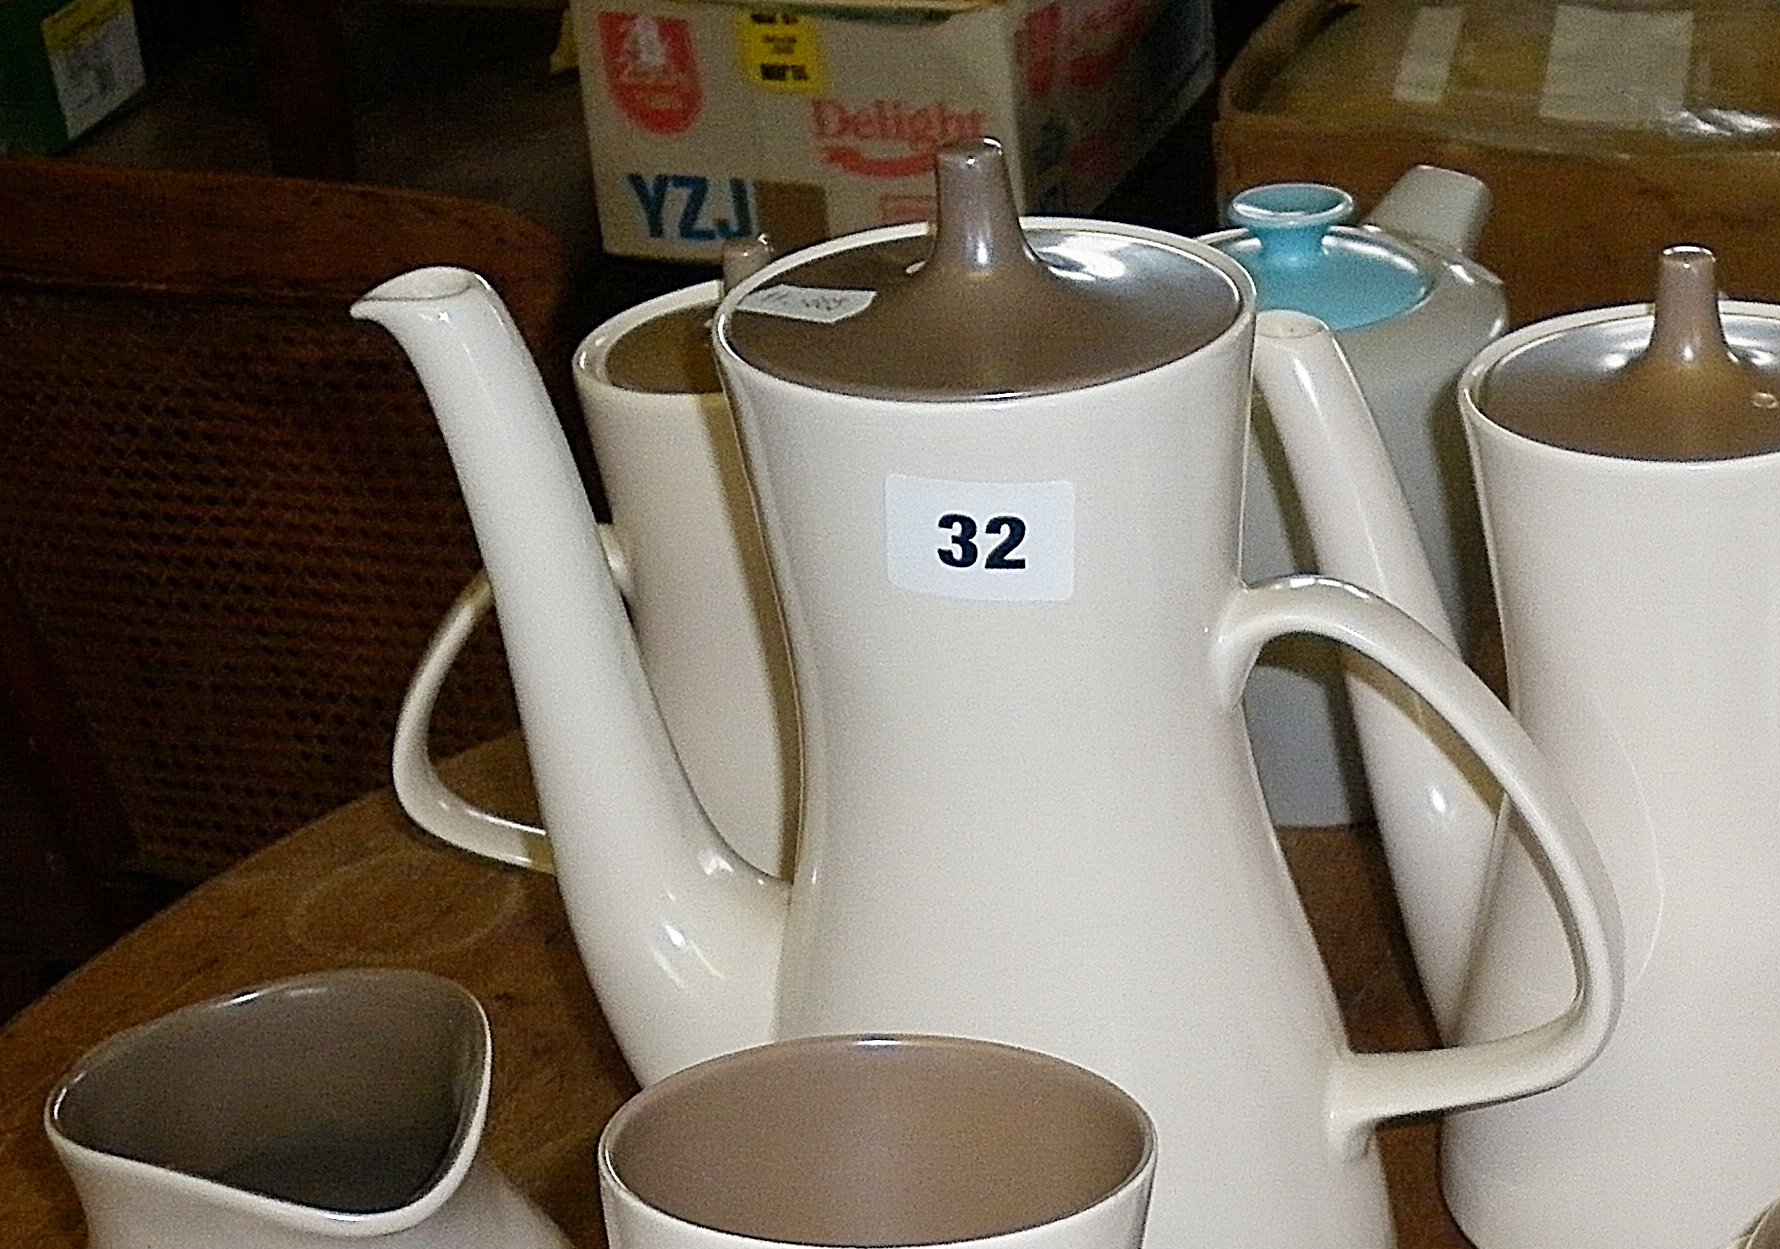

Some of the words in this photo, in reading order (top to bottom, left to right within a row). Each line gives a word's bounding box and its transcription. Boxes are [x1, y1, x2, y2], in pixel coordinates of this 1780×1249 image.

[812, 98, 986, 150] Delight
[627, 172, 753, 241] YZJ
[937, 513, 1026, 569] 32
